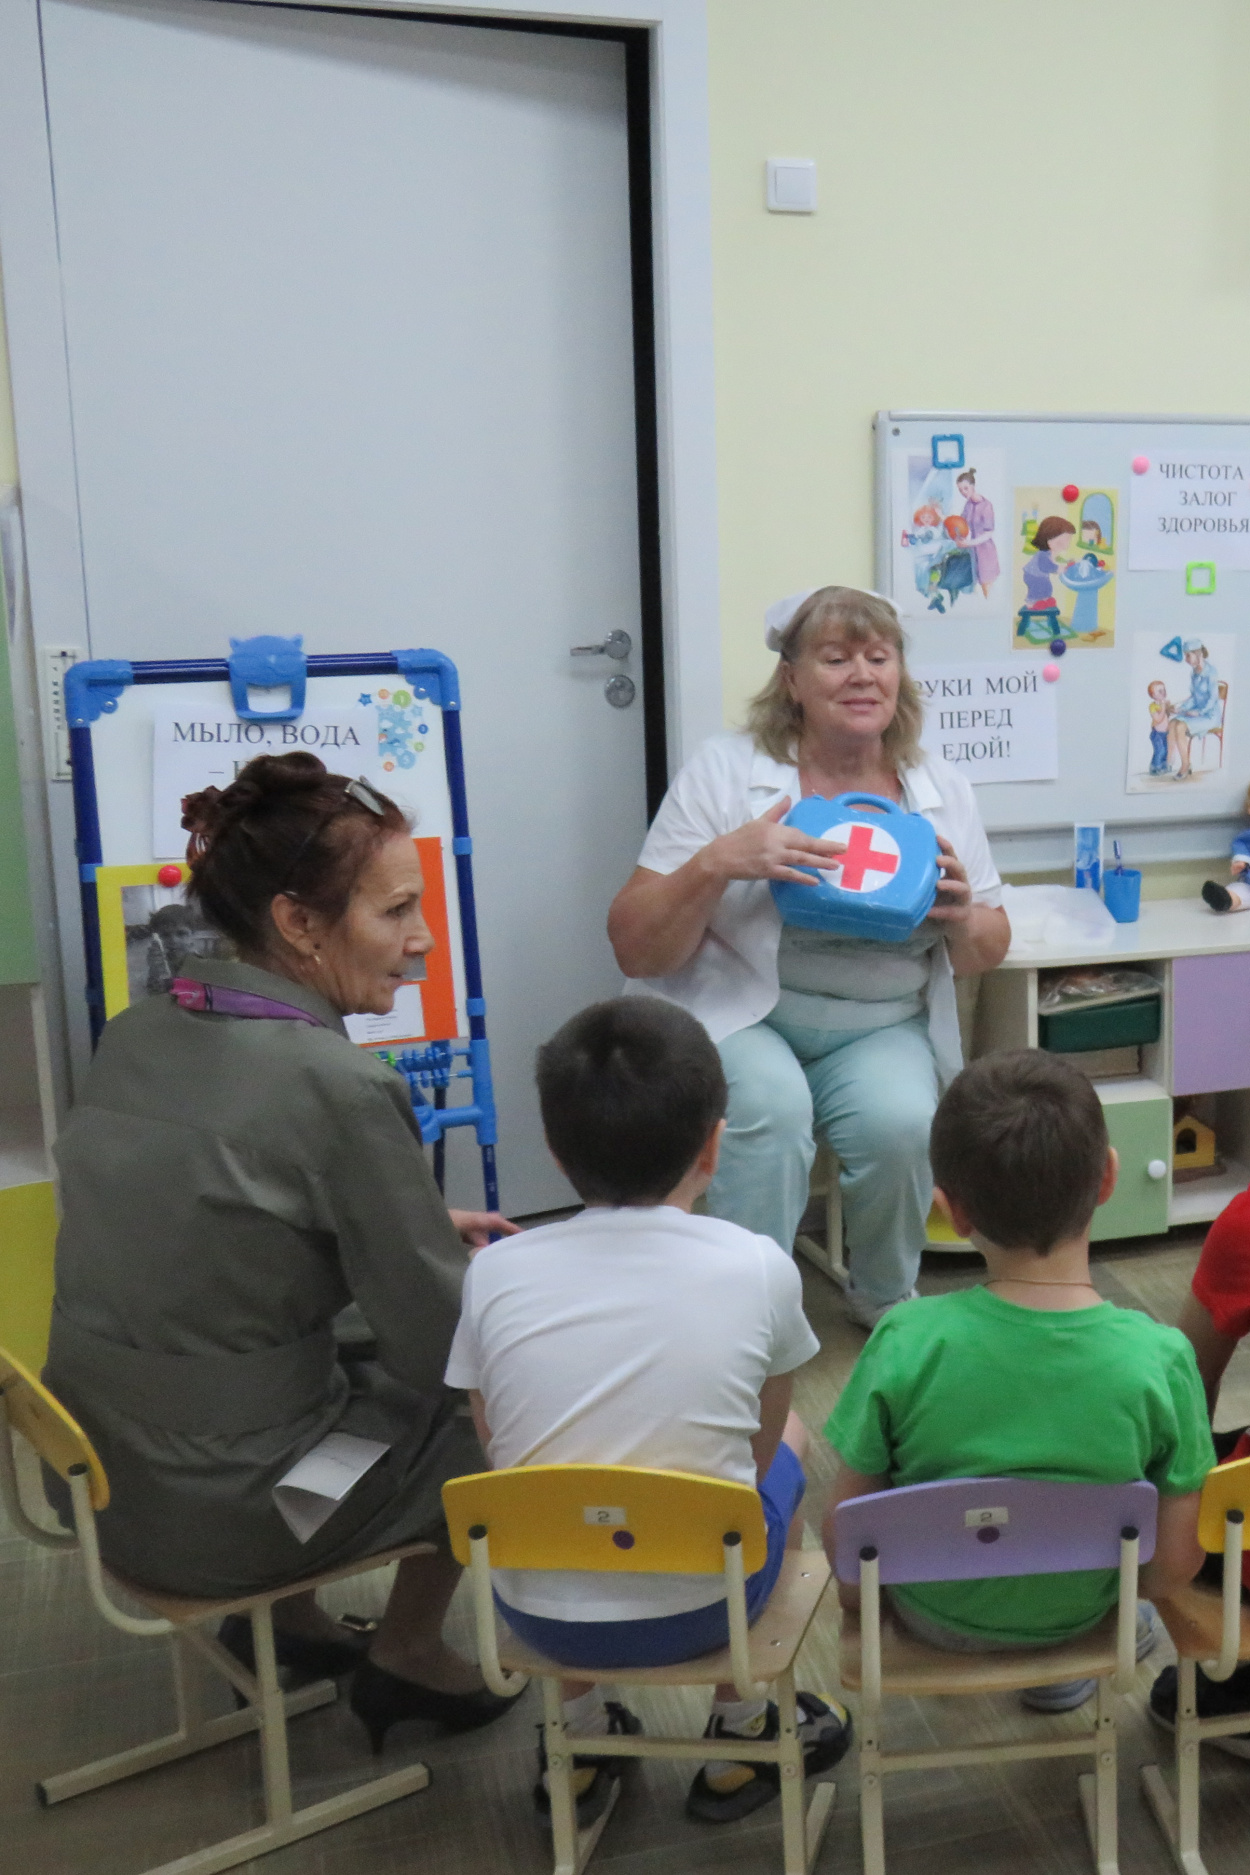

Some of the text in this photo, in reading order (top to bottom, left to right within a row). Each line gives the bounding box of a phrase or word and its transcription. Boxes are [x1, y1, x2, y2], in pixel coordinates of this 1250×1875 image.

[1159, 463, 1245, 481] ЧИСТОТА
[1179, 491, 1238, 507] ЗАЛОГ
[985, 670, 1038, 695] МОЙ
[939, 708, 1013, 730] ПЕРЕД
[172, 721, 361, 749] МЫЛО, ВОДА
[942, 736, 1011, 765] ЕДОЙ!
[597, 1510, 611, 1523] 2
[980, 1511, 994, 1523] 2
